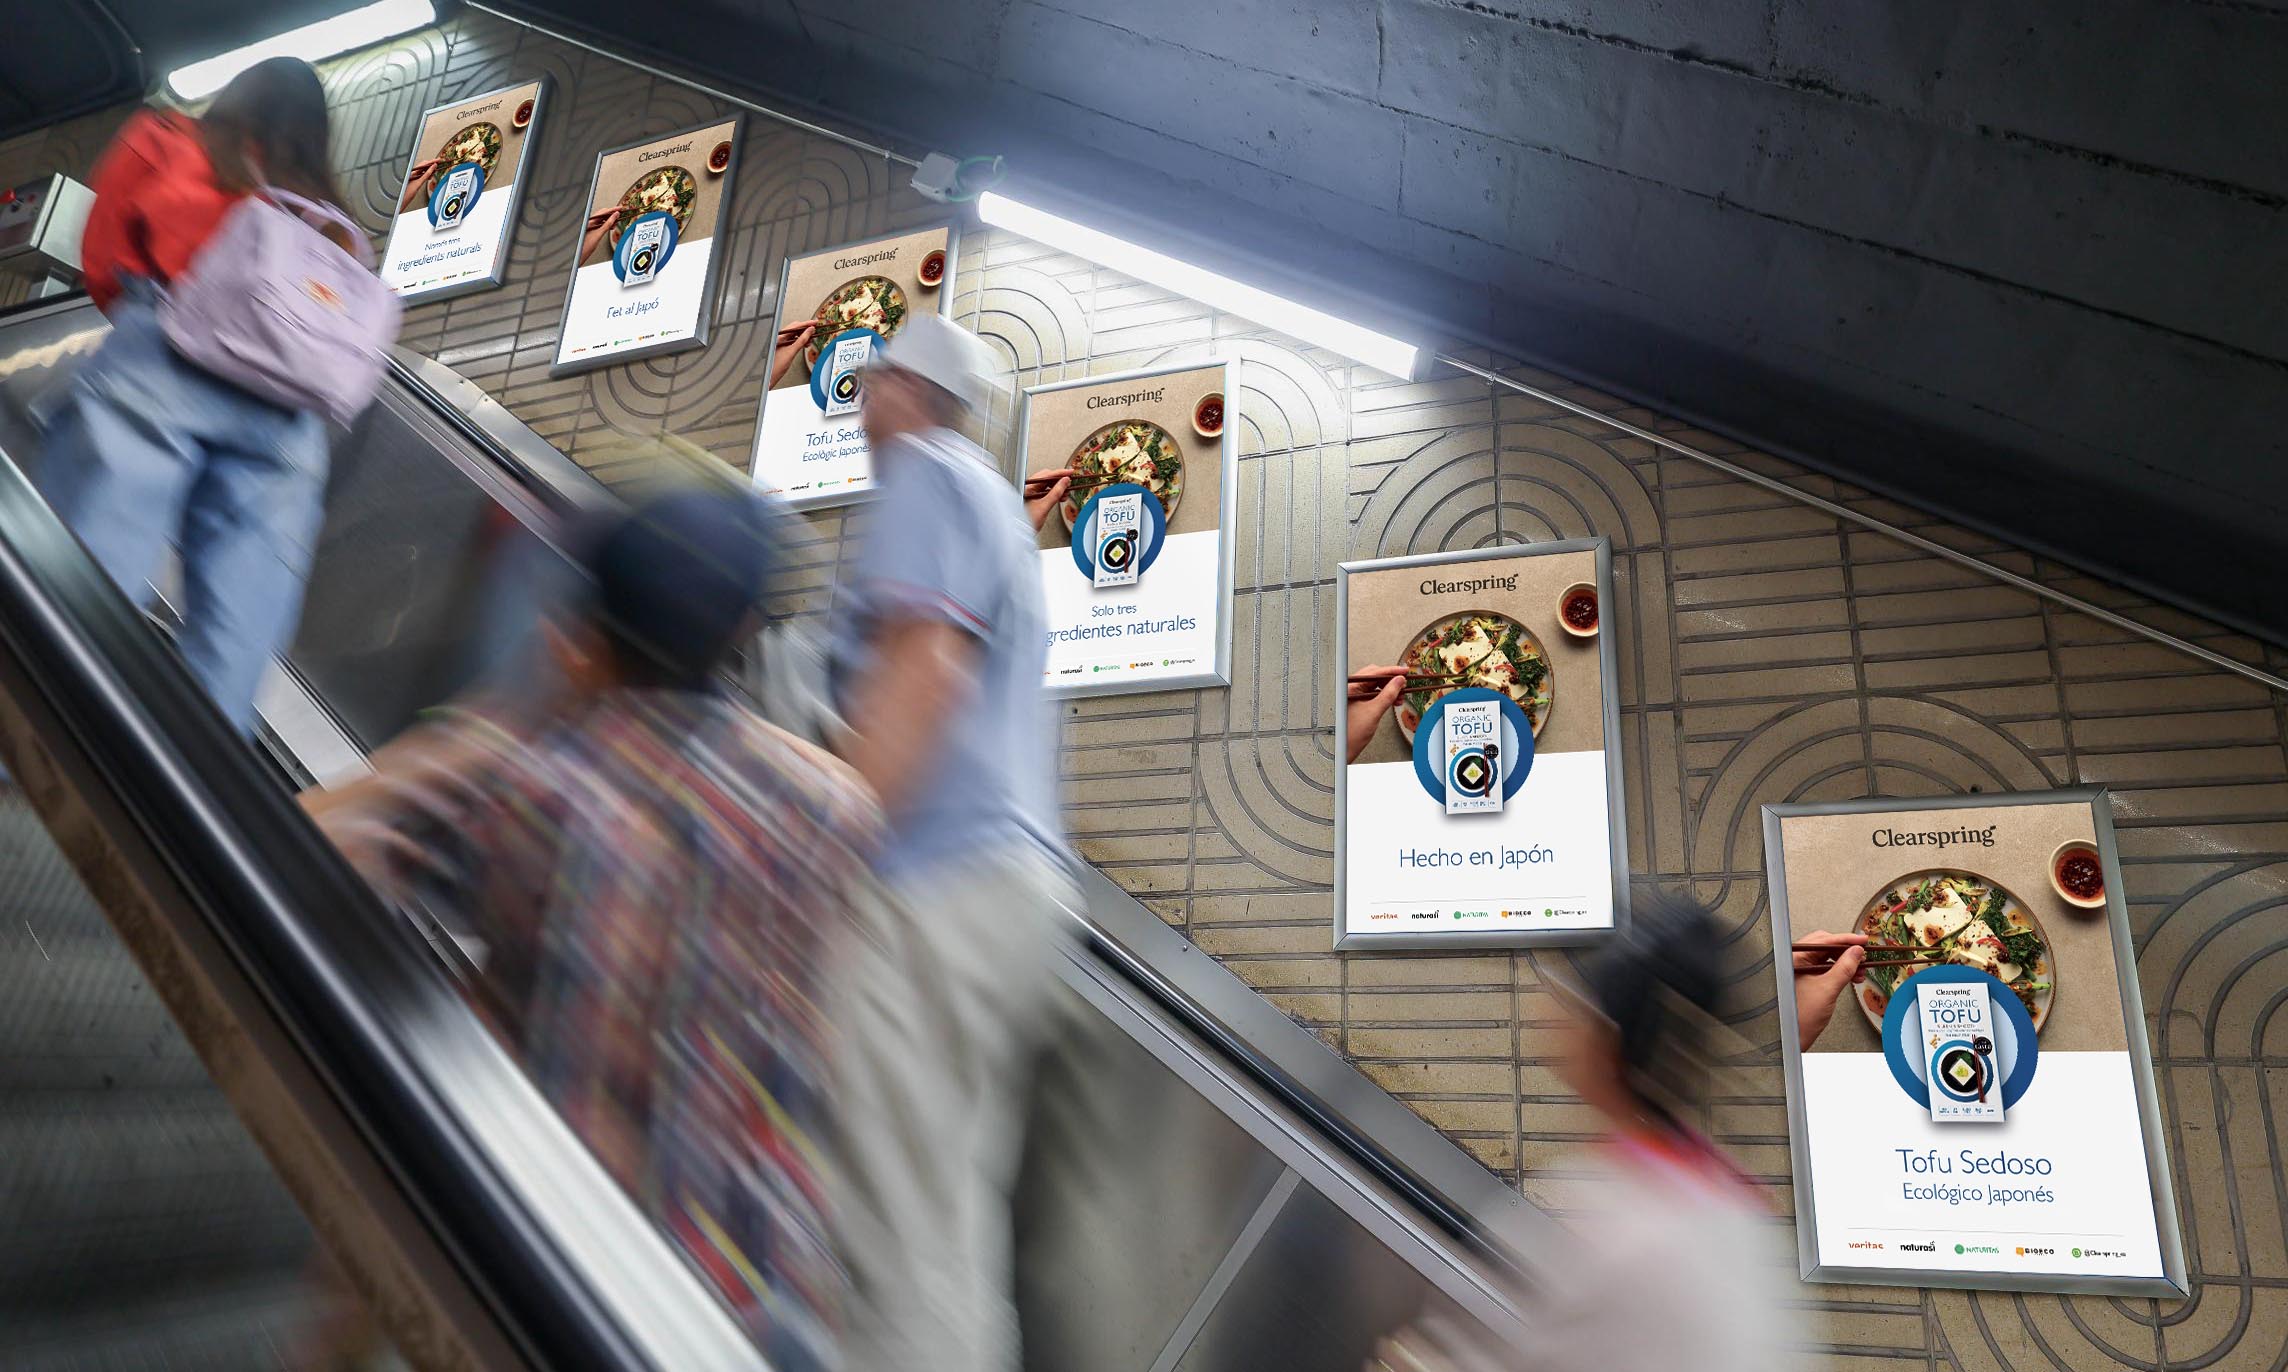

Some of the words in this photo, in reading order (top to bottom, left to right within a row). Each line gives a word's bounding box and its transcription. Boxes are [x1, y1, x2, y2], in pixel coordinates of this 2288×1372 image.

[456, 99, 503, 120] Clearspring
[638, 140, 694, 163] Clearspring
[637, 230, 659, 241] TOFU
[397, 253, 444, 272] ingredients
[446, 242, 483, 260] naturals
[834, 248, 900, 270] Clearspring
[624, 302, 635, 315] al
[634, 297, 660, 315] Japó
[838, 351, 865, 363] TOFU
[1086, 386, 1166, 410] Clearspring
[806, 431, 833, 447] Tofu
[1103, 511, 1135, 524] TOFU
[1420, 573, 1519, 596] Clearspring
[1091, 605, 1114, 618] Solo
[1117, 604, 1138, 615] tres
[1126, 615, 1196, 636] naturales
[1452, 714, 1491, 723] ORGANIC
[1451, 721, 1493, 736] TOFU
[1872, 825, 1997, 848] Clearspring
[1399, 847, 1463, 868] Hecho
[1469, 850, 1494, 866] en
[1498, 843, 1554, 870] Japón
[1928, 999, 1980, 1008] ORGANIC
[1928, 1009, 1982, 1024] TOFU
[1895, 1149, 1952, 1174] Tofu
[1960, 1150, 2053, 1176] Sedoso
[1903, 1182, 1983, 1206] Ecológico
[1987, 1184, 2055, 1207] Japonés
[1848, 1240, 1884, 1250] veritas
